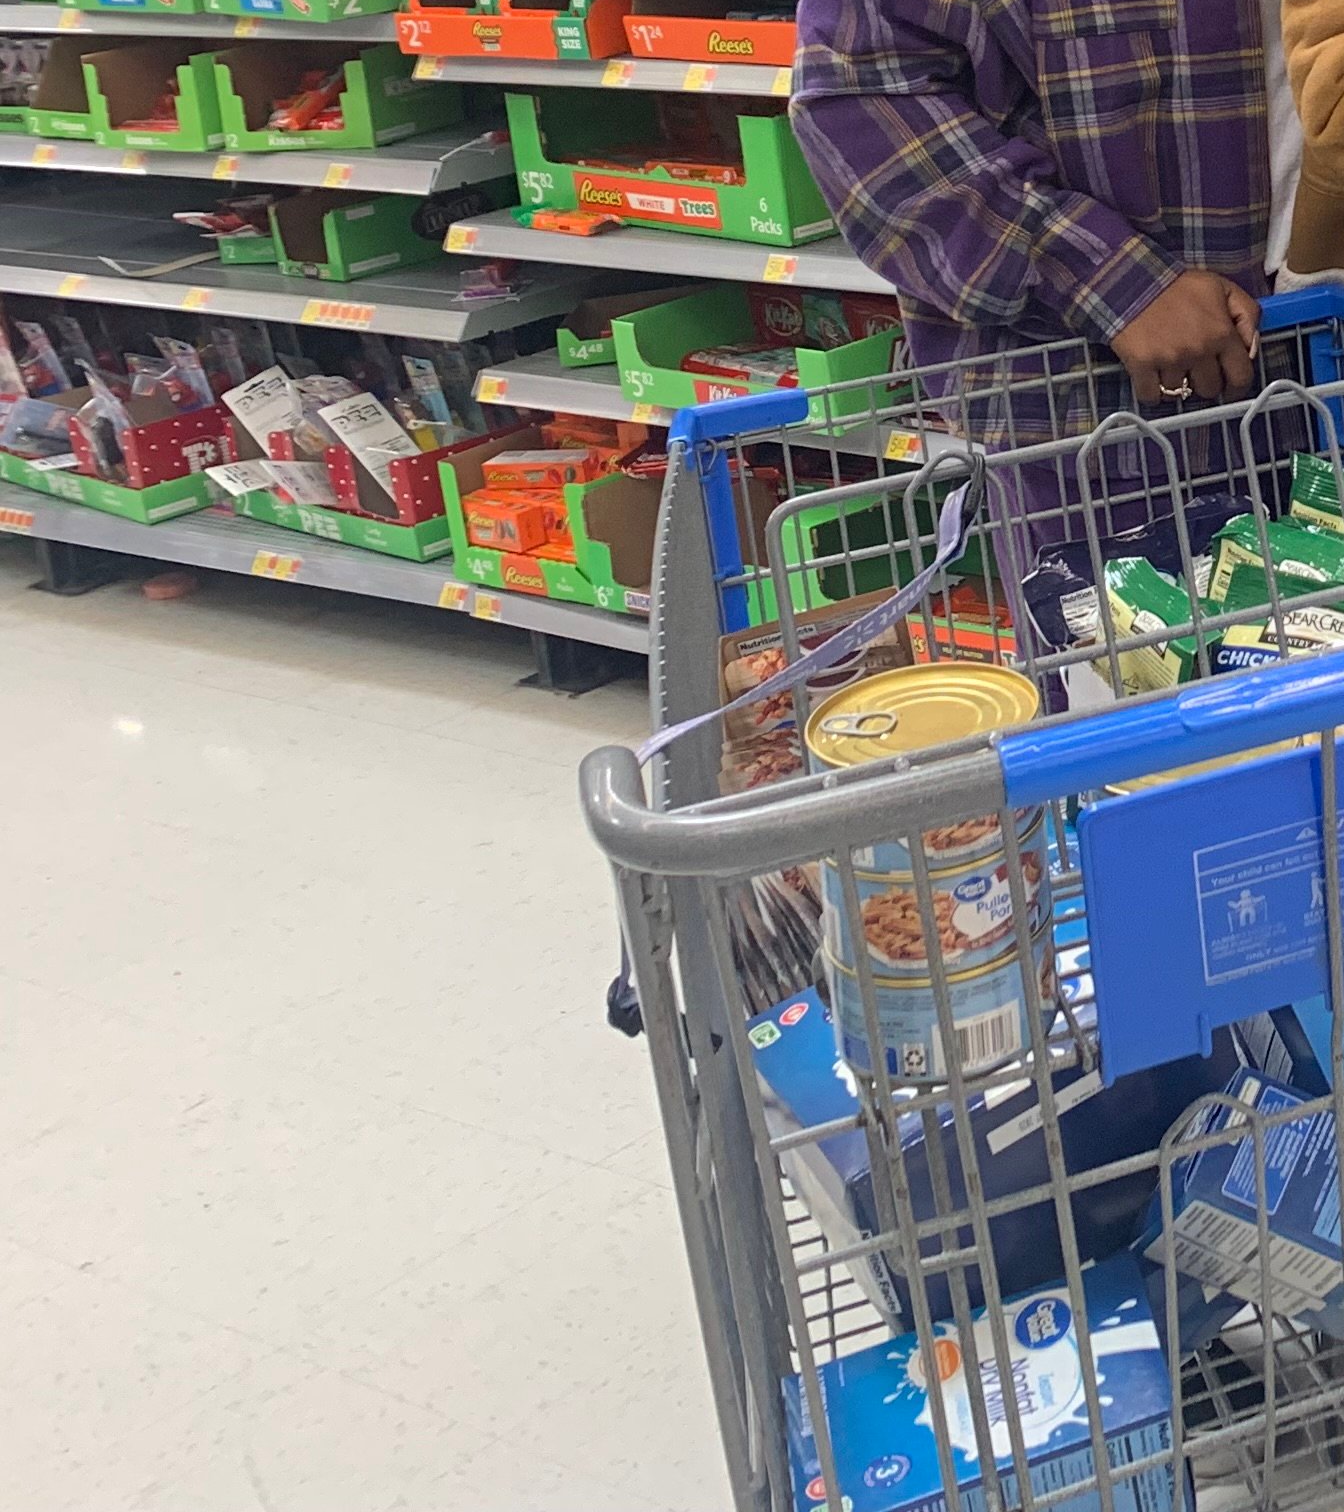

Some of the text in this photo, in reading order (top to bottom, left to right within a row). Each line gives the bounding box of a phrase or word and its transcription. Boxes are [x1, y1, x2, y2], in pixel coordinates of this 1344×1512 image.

[557, 25, 580, 38] KING
[631, 23, 663, 53] $124
[560, 37, 582, 50] SIZE
[707, 31, 754, 55] Reese's
[522, 172, 554, 203] $582
[579, 178, 715, 218] Reese's WHITE Trees
[759, 196, 768, 213] 6
[750, 217, 784, 236] Packs
